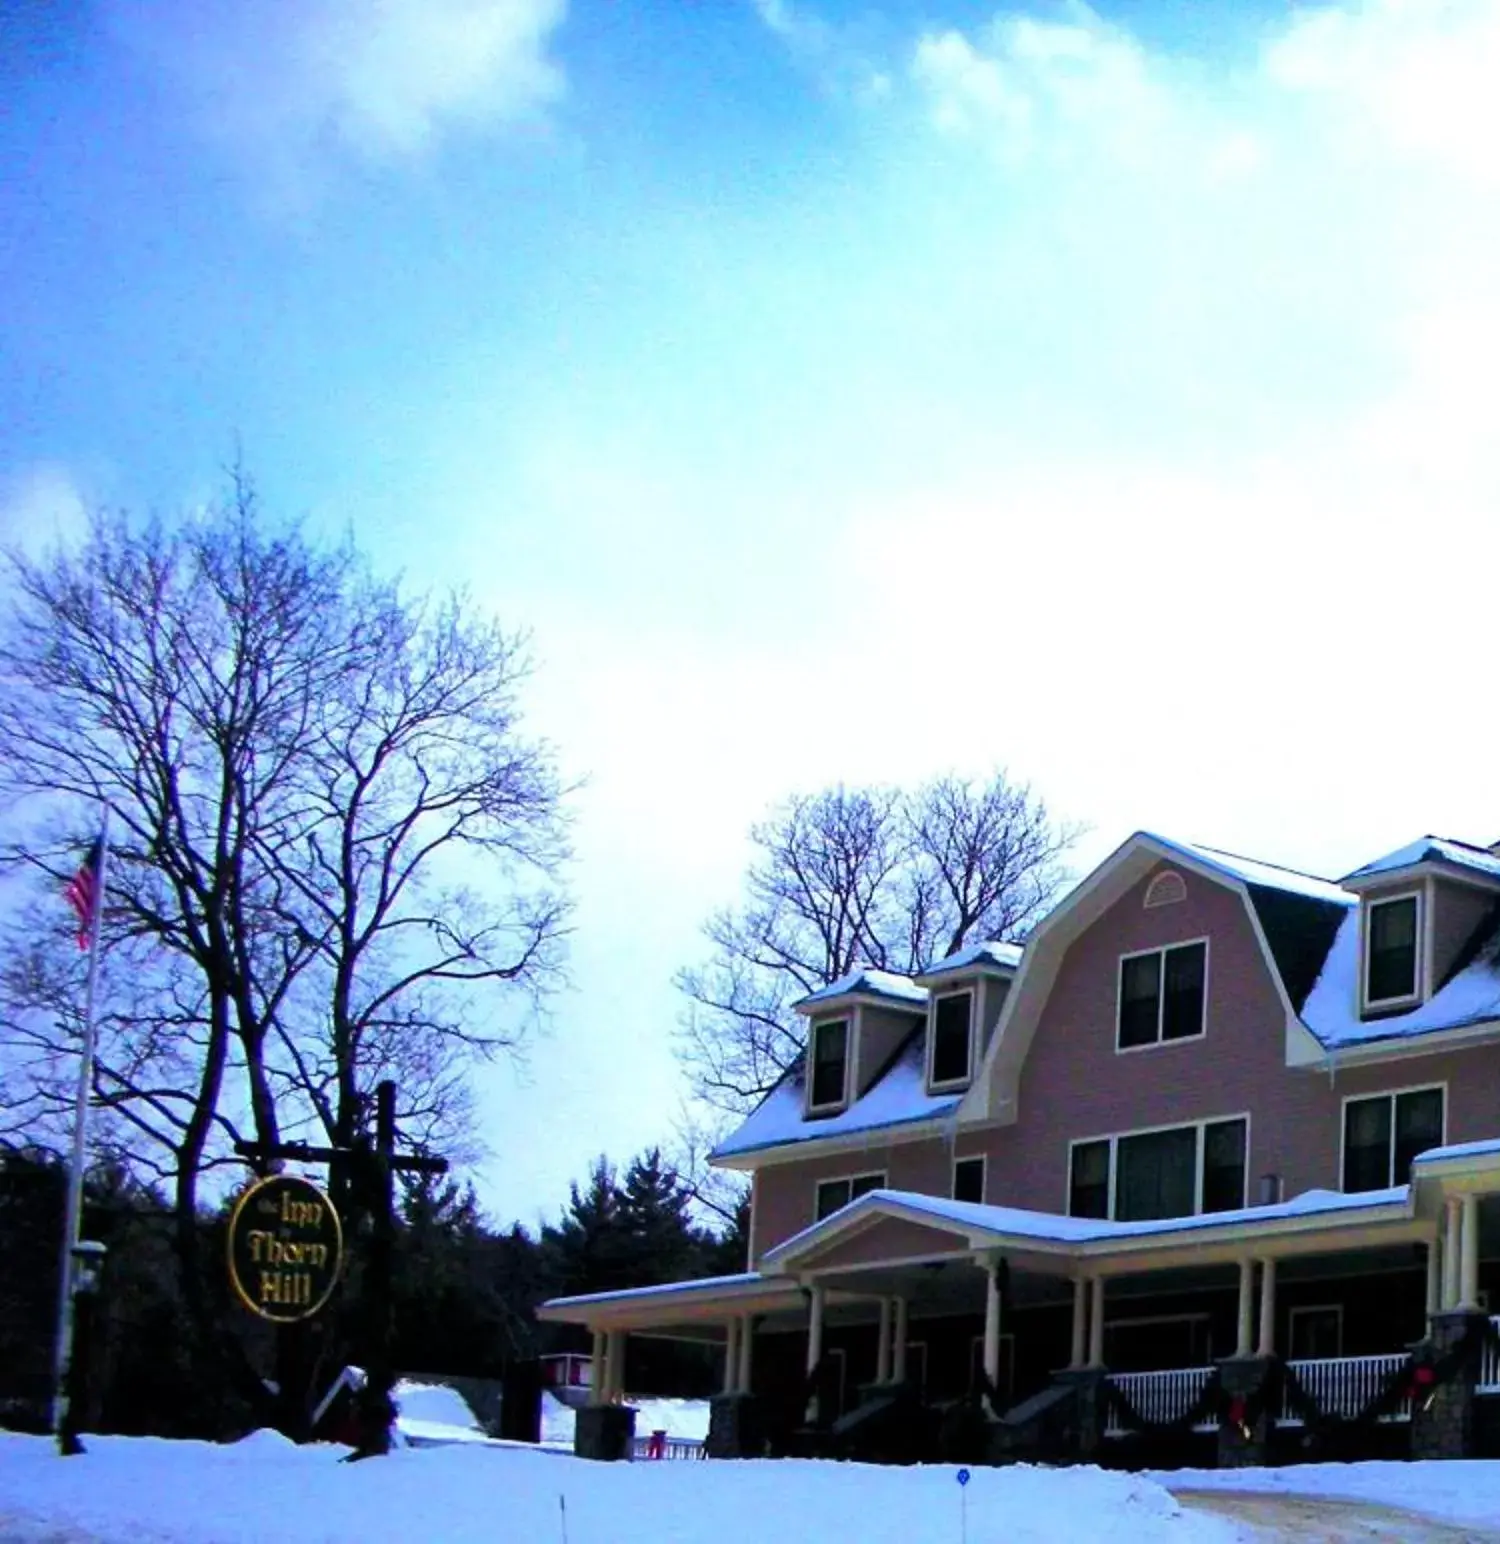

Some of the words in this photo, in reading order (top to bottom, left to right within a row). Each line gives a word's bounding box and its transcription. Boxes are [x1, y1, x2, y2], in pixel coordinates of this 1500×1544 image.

[281, 1191, 323, 1228] Inn
[248, 1229, 328, 1269] Thorn
[261, 1271, 311, 1304] Hill
